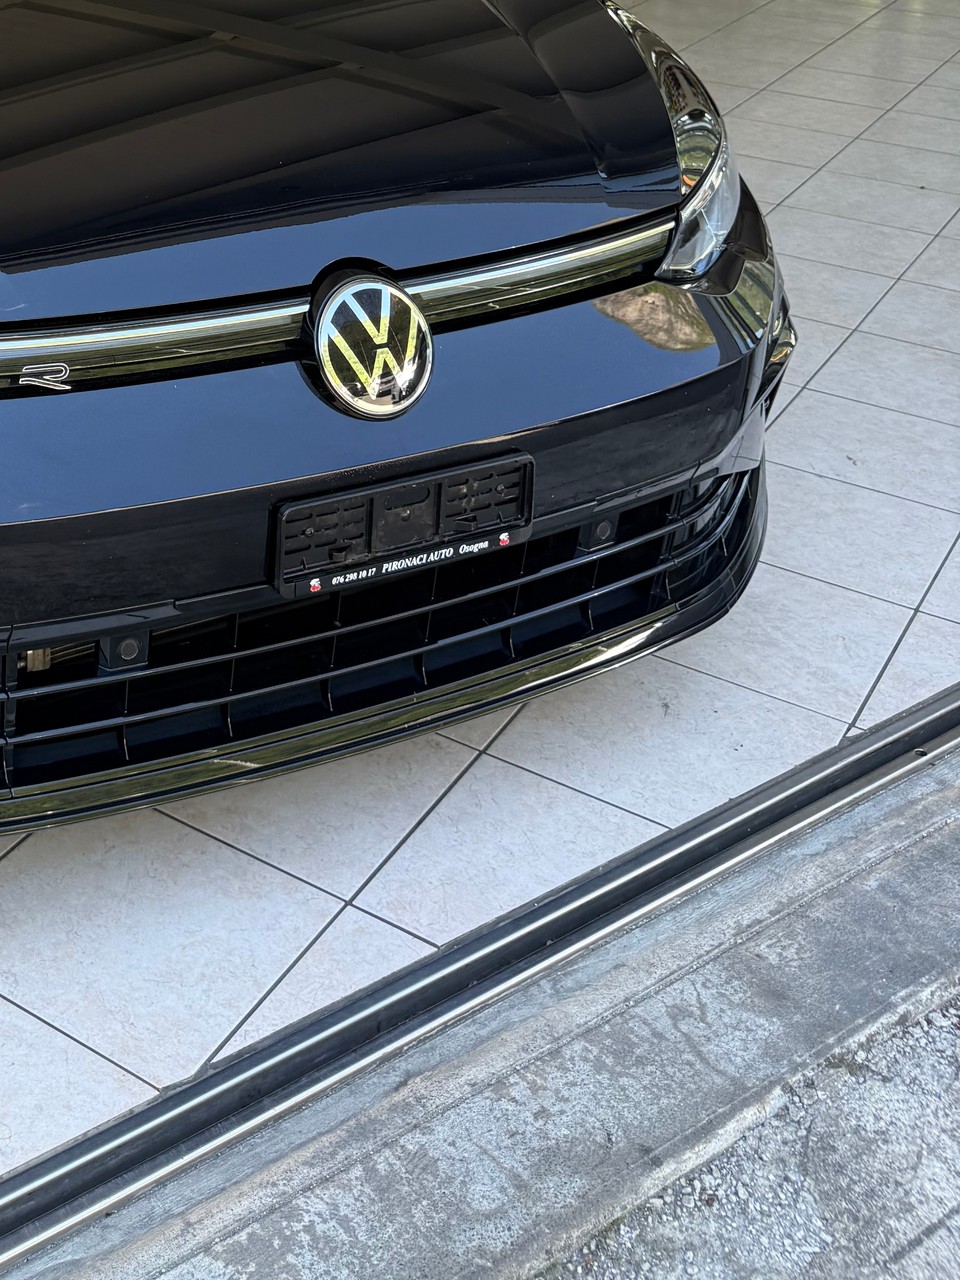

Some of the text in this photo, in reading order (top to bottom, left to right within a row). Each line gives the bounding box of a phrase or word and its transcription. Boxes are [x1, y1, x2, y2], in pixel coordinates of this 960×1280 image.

[331, 540, 489, 585] 076 298 10 17 PIRONACI AUTO Osogna
